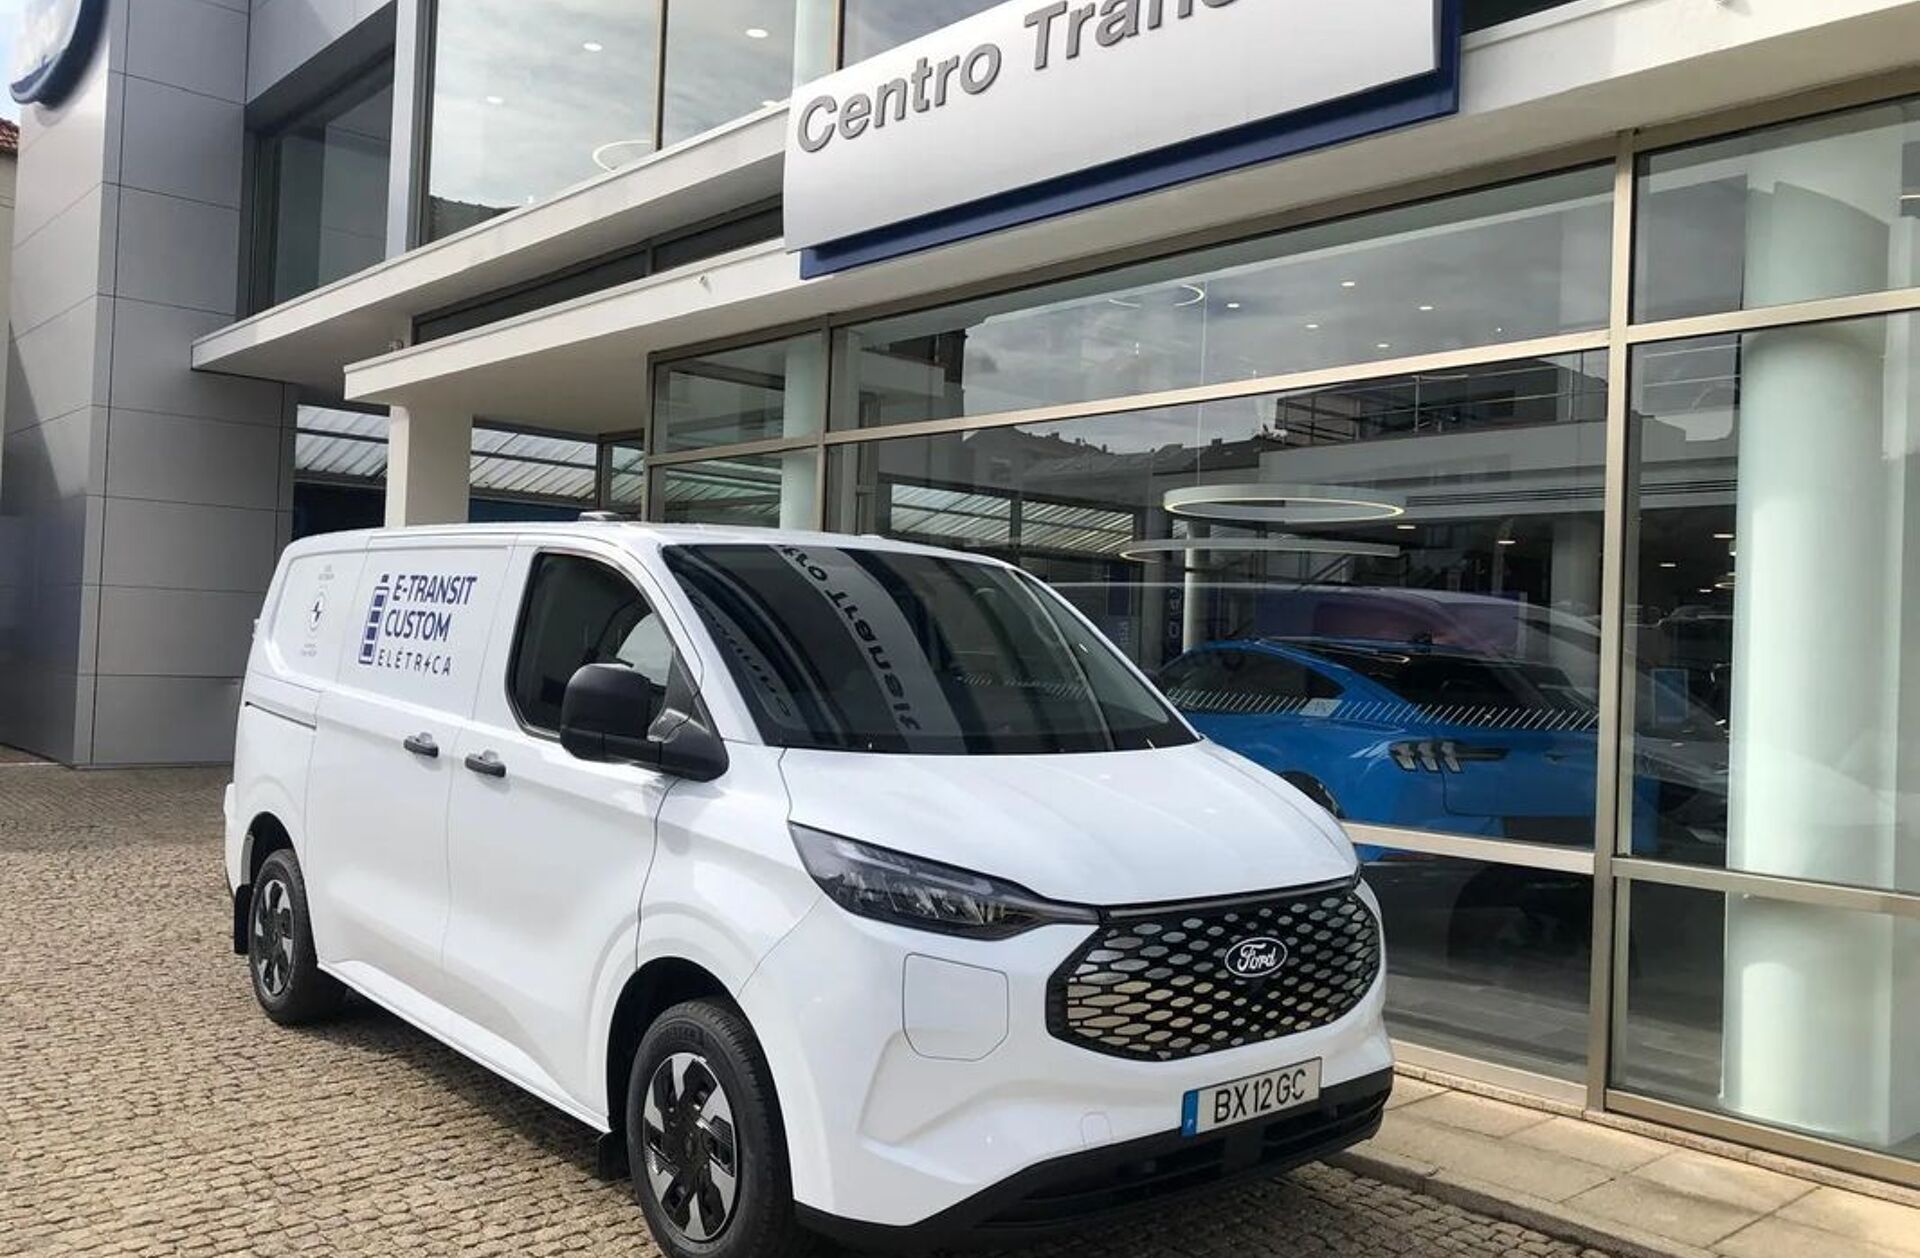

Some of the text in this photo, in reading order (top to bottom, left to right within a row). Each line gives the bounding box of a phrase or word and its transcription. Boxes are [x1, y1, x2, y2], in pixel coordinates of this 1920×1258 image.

[797, 42, 1002, 153] Centro
[393, 574, 478, 605] E-TRANSIT
[385, 609, 451, 642] CUSTOM
[1237, 943, 1276, 972] Ford
